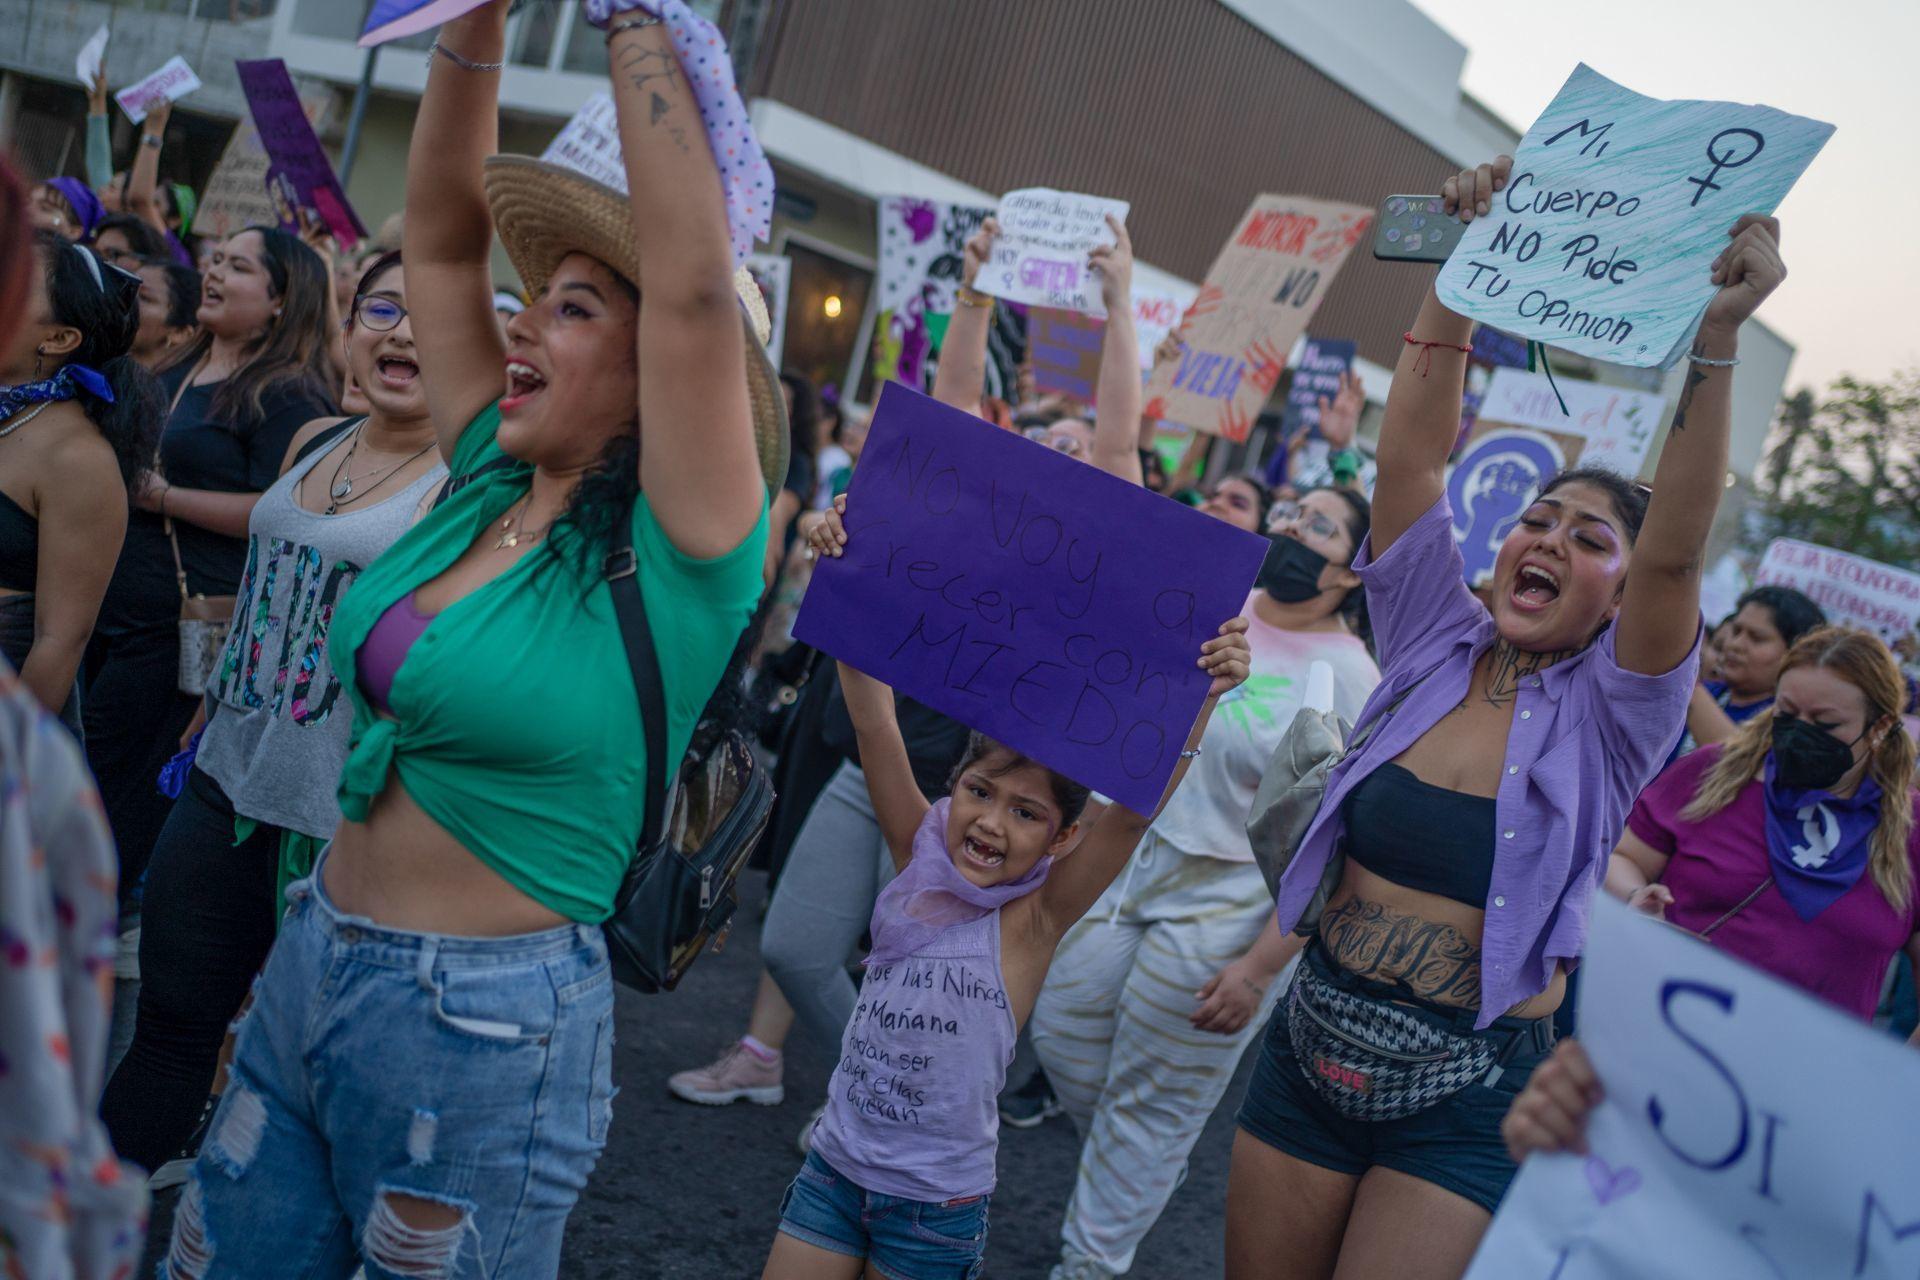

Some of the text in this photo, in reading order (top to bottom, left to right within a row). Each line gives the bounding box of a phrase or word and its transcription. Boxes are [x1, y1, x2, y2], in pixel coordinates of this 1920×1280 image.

[1506, 172, 1641, 219] Cuerpo
[1488, 221, 1638, 285] NO Pide
[1272, 268, 1319, 308] NO
[891, 436, 960, 516] NO
[1154, 589, 1195, 642] a
[889, 612, 1165, 780] MIEDO
[1064, 635, 1168, 712] con
[868, 1000, 958, 1035] Mañana
[899, 1052, 935, 1072] ser
[1318, 1058, 1367, 1089] LOVE
